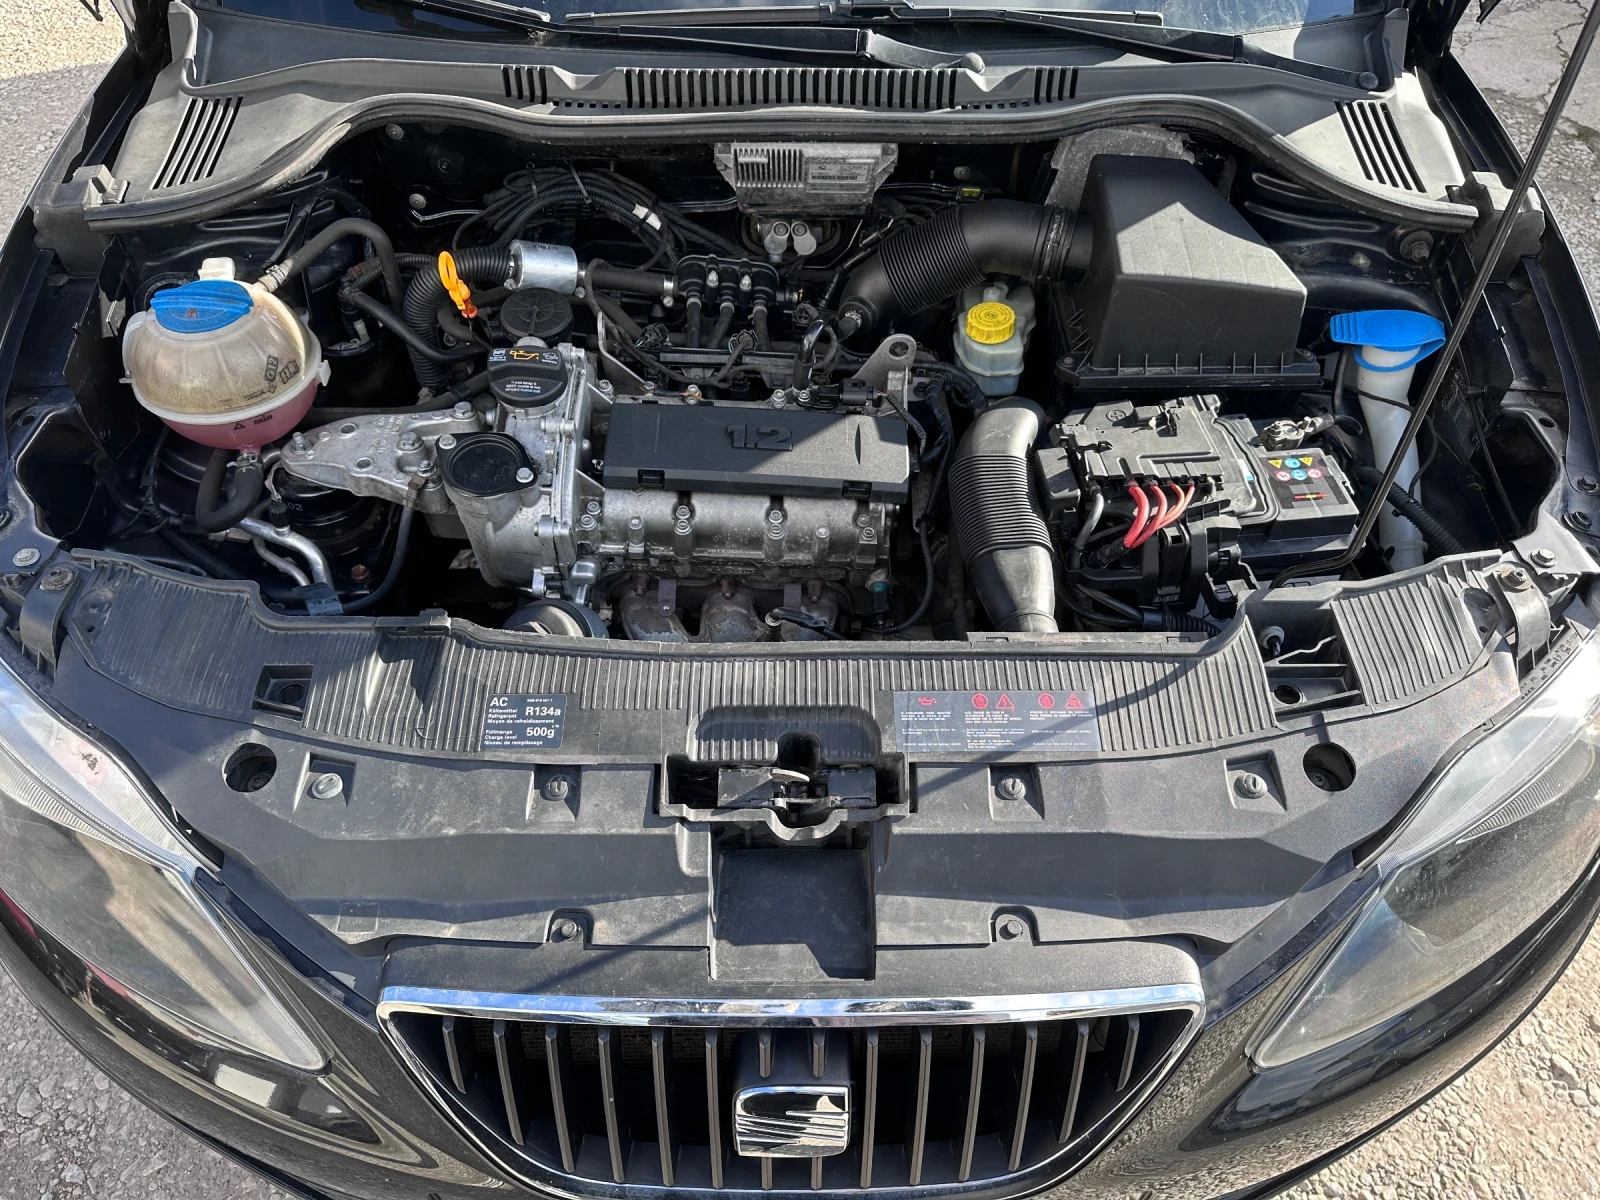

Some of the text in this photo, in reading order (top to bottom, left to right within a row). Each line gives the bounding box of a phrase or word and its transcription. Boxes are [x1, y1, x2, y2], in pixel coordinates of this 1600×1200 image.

[266, 358, 278, 379] G12
[253, 414, 273, 425] min
[725, 424, 794, 452] 1.2
[489, 697, 509, 707] AC
[525, 706, 561, 716] R134a
[526, 727, 555, 739] 500g
